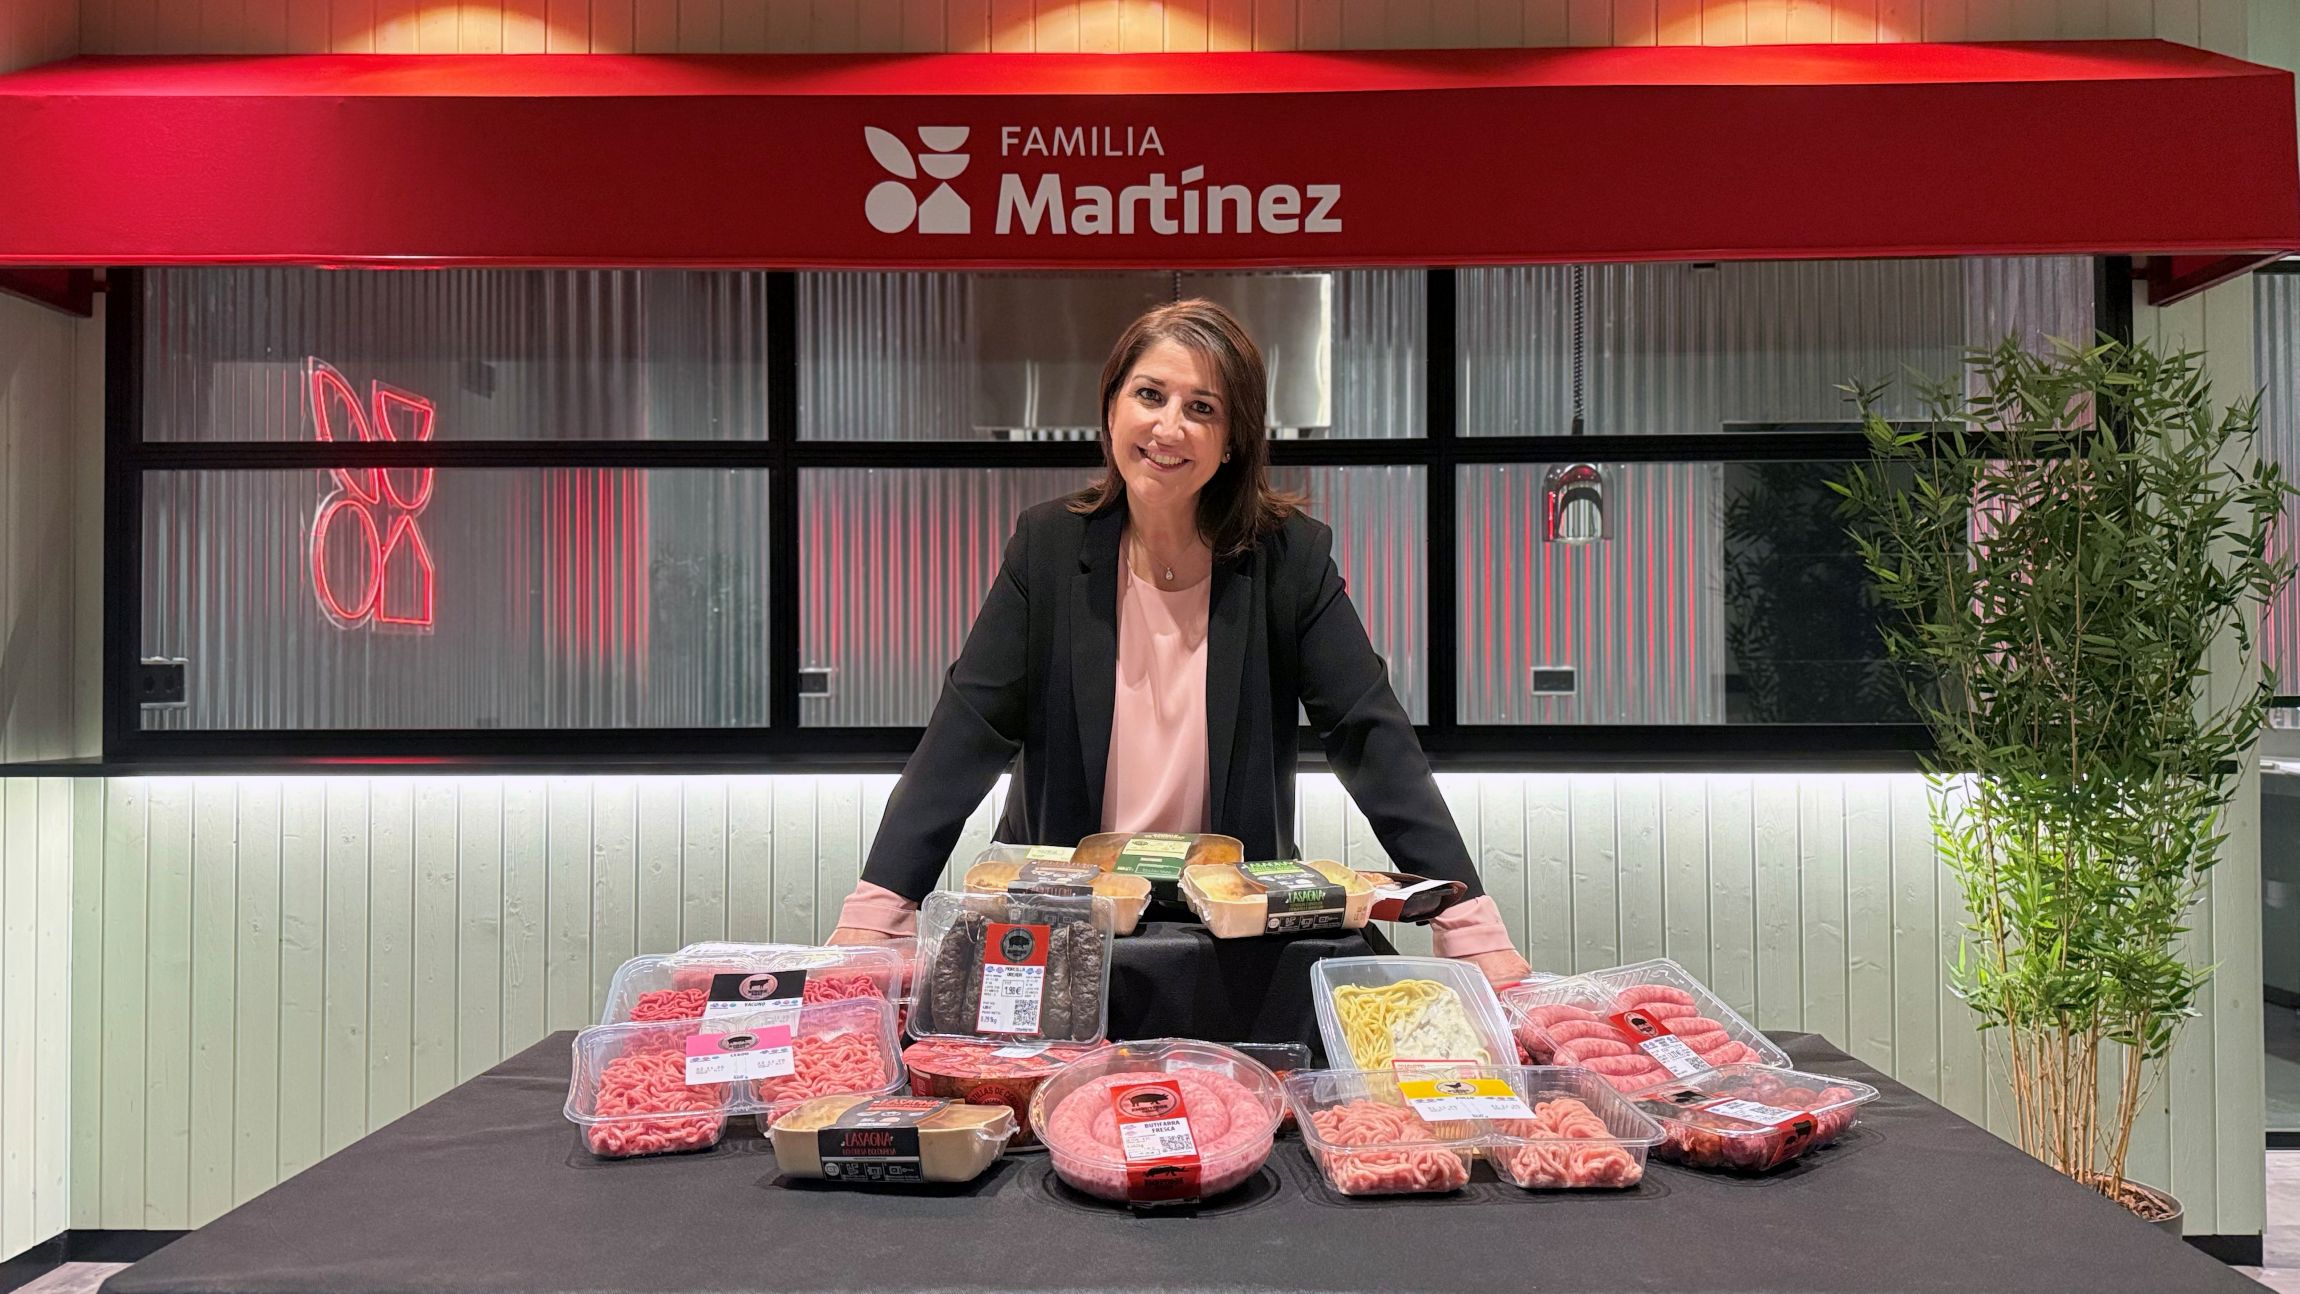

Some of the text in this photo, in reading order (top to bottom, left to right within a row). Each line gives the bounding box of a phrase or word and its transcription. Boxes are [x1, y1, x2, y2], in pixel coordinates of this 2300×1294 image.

[1001, 126, 1165, 156] FAMILIA
[995, 165, 1343, 235] Martínez
[1144, 1120, 1181, 1129] BUTIFARRA
[1151, 1126, 1176, 1134] FRESCA
[845, 1131, 892, 1147] LASAGNA
